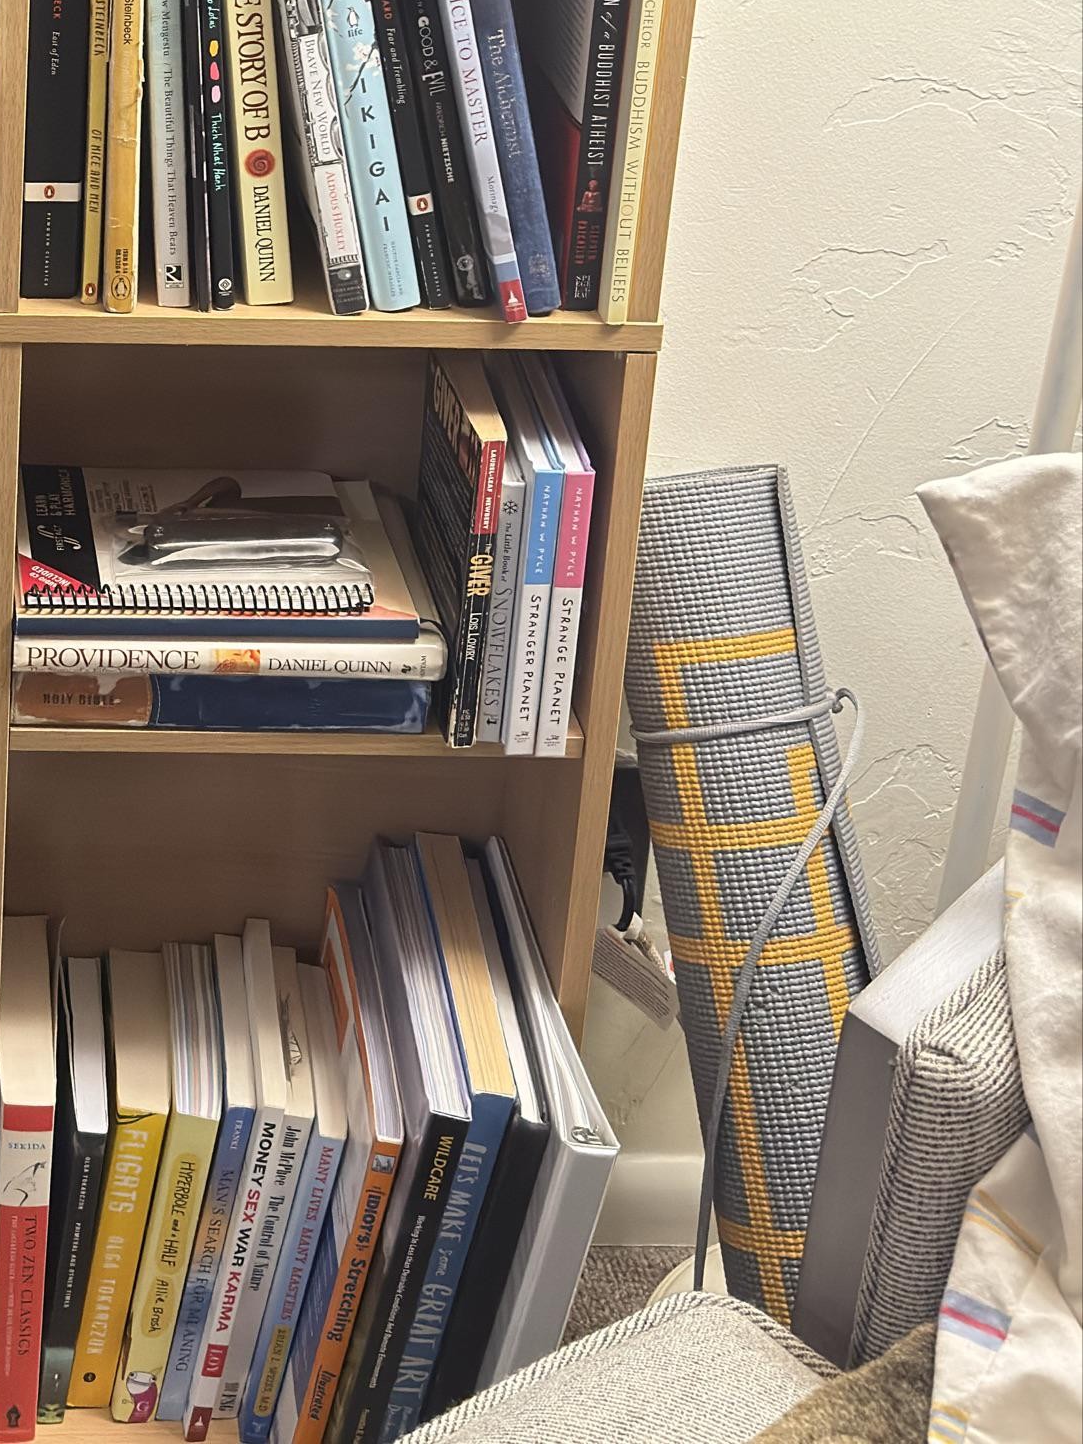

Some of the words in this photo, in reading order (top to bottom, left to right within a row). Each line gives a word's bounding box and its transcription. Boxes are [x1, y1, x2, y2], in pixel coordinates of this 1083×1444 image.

[236, 12, 267, 86] STORY
[457, 38, 472, 61] TO
[242, 90, 269, 119] OF
[462, 68, 488, 145] MASTER
[625, 59, 650, 151] BUDDHISM
[244, 123, 271, 141] B
[253, 185, 272, 236] DANIEL
[615, 156, 639, 240] WITHOUT
[254, 235, 275, 282] QUINN
[609, 247, 630, 302] BELIEFS
[540, 485, 551, 527] NATHAN
[535, 548, 545, 573] PYLE
[538, 532, 545, 542] W
[525, 594, 542, 665] STRANGER
[556, 597, 574, 663] STRANGE
[27, 646, 200, 672] PROVIDENCE
[268, 657, 331, 673] DANIEL
[334, 659, 392, 674] QUINN
[519, 671, 534, 721] PLANET
[550, 672, 566, 725] PLANET
[109, 1129, 148, 1212] FLIGHTS
[251, 1122, 276, 1187] MONEY
[424, 1136, 454, 1200] WILDCARE
[242, 1189, 260, 1224] SEX
[231, 1227, 252, 1267] WAR
[216, 1271, 241, 1332] KARMA
[327, 1258, 366, 1342] Stretching
